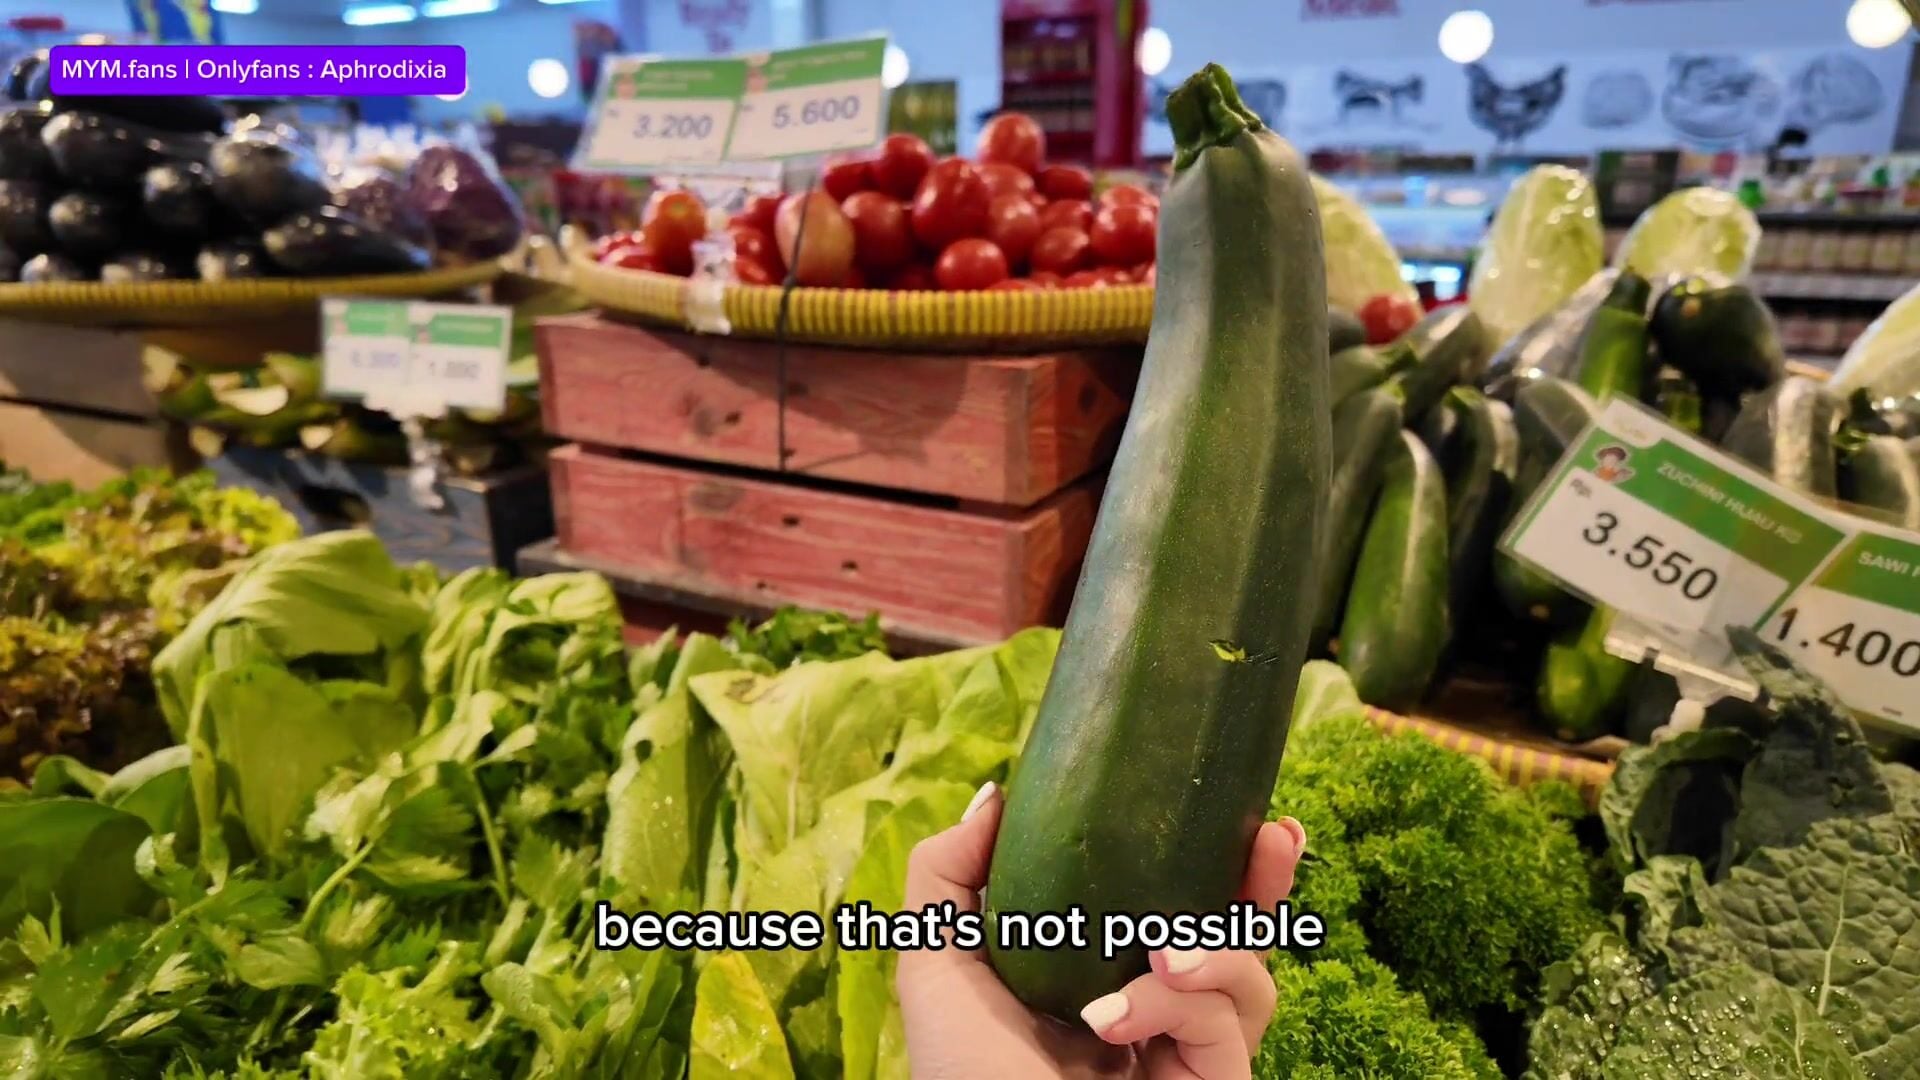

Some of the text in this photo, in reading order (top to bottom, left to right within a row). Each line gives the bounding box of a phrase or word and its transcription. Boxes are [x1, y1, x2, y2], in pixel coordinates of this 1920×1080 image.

[632, 113, 714, 141] 3.200
[772, 95, 861, 130] 5.600
[1582, 511, 1719, 601] 3.550
[1857, 550, 1911, 575] SAWI
[1776, 606, 1920, 678] 1.400
